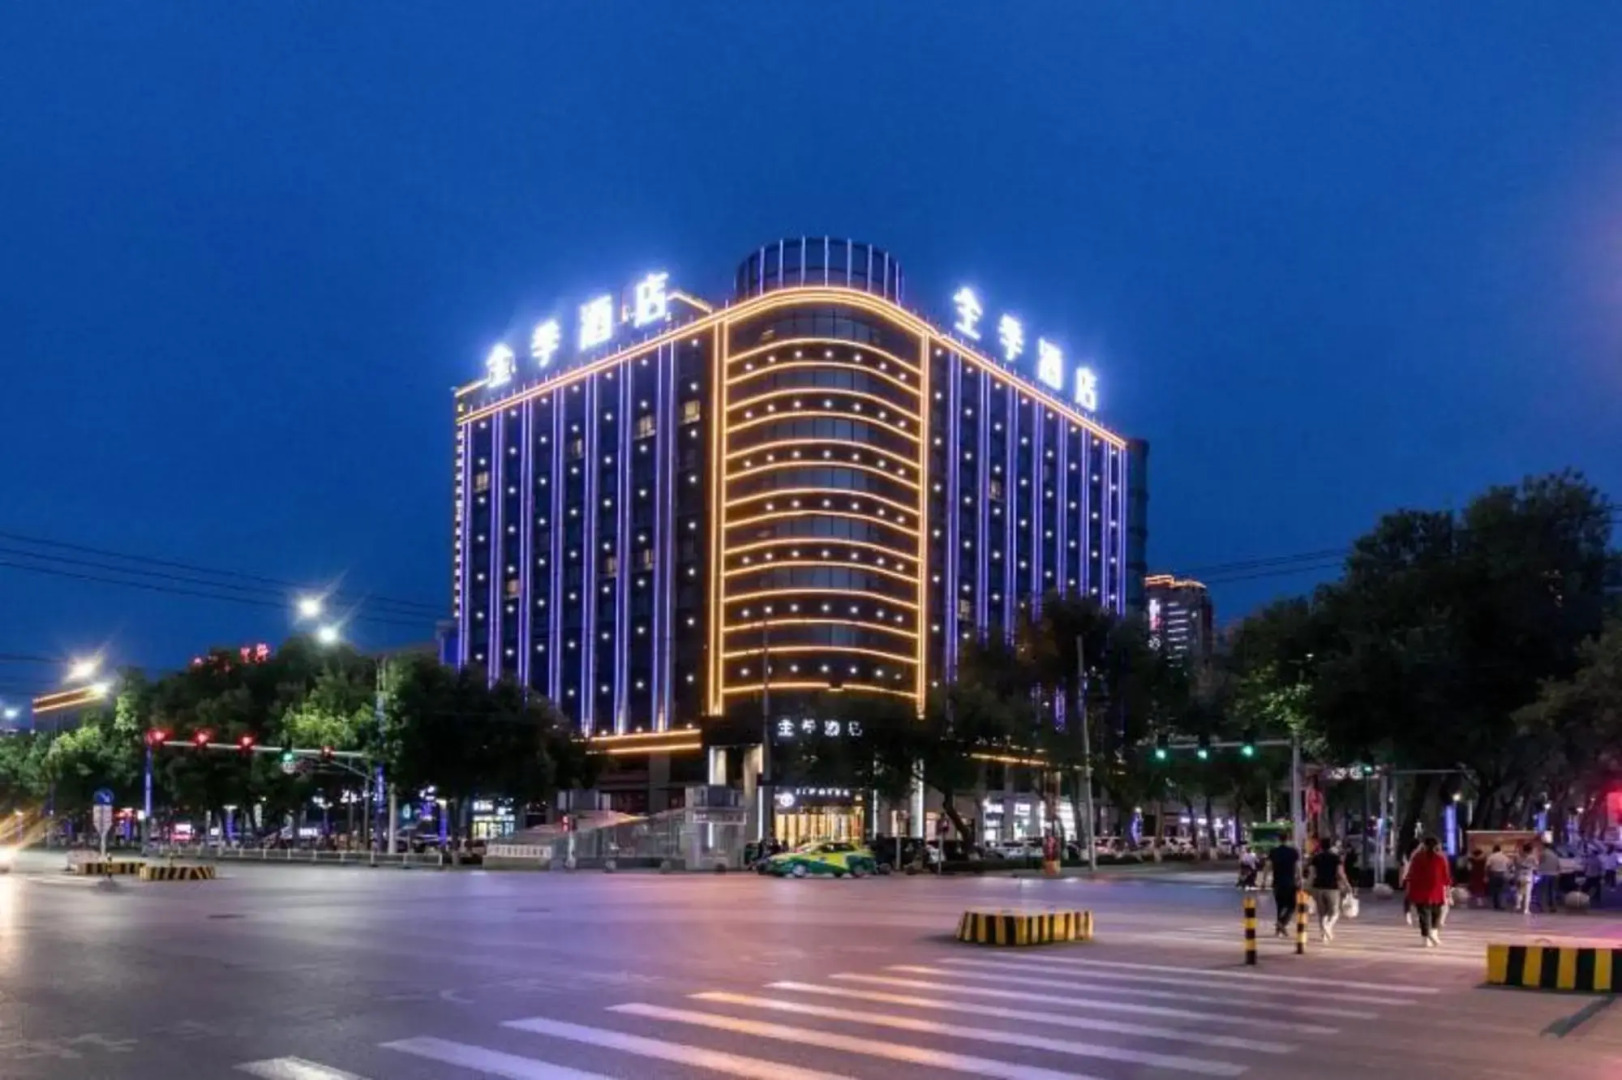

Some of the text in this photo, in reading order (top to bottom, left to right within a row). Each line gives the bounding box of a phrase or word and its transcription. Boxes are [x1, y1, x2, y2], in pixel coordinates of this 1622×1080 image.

[486, 271, 669, 388] 全季酒店
[953, 286, 1098, 411] 全季酒店
